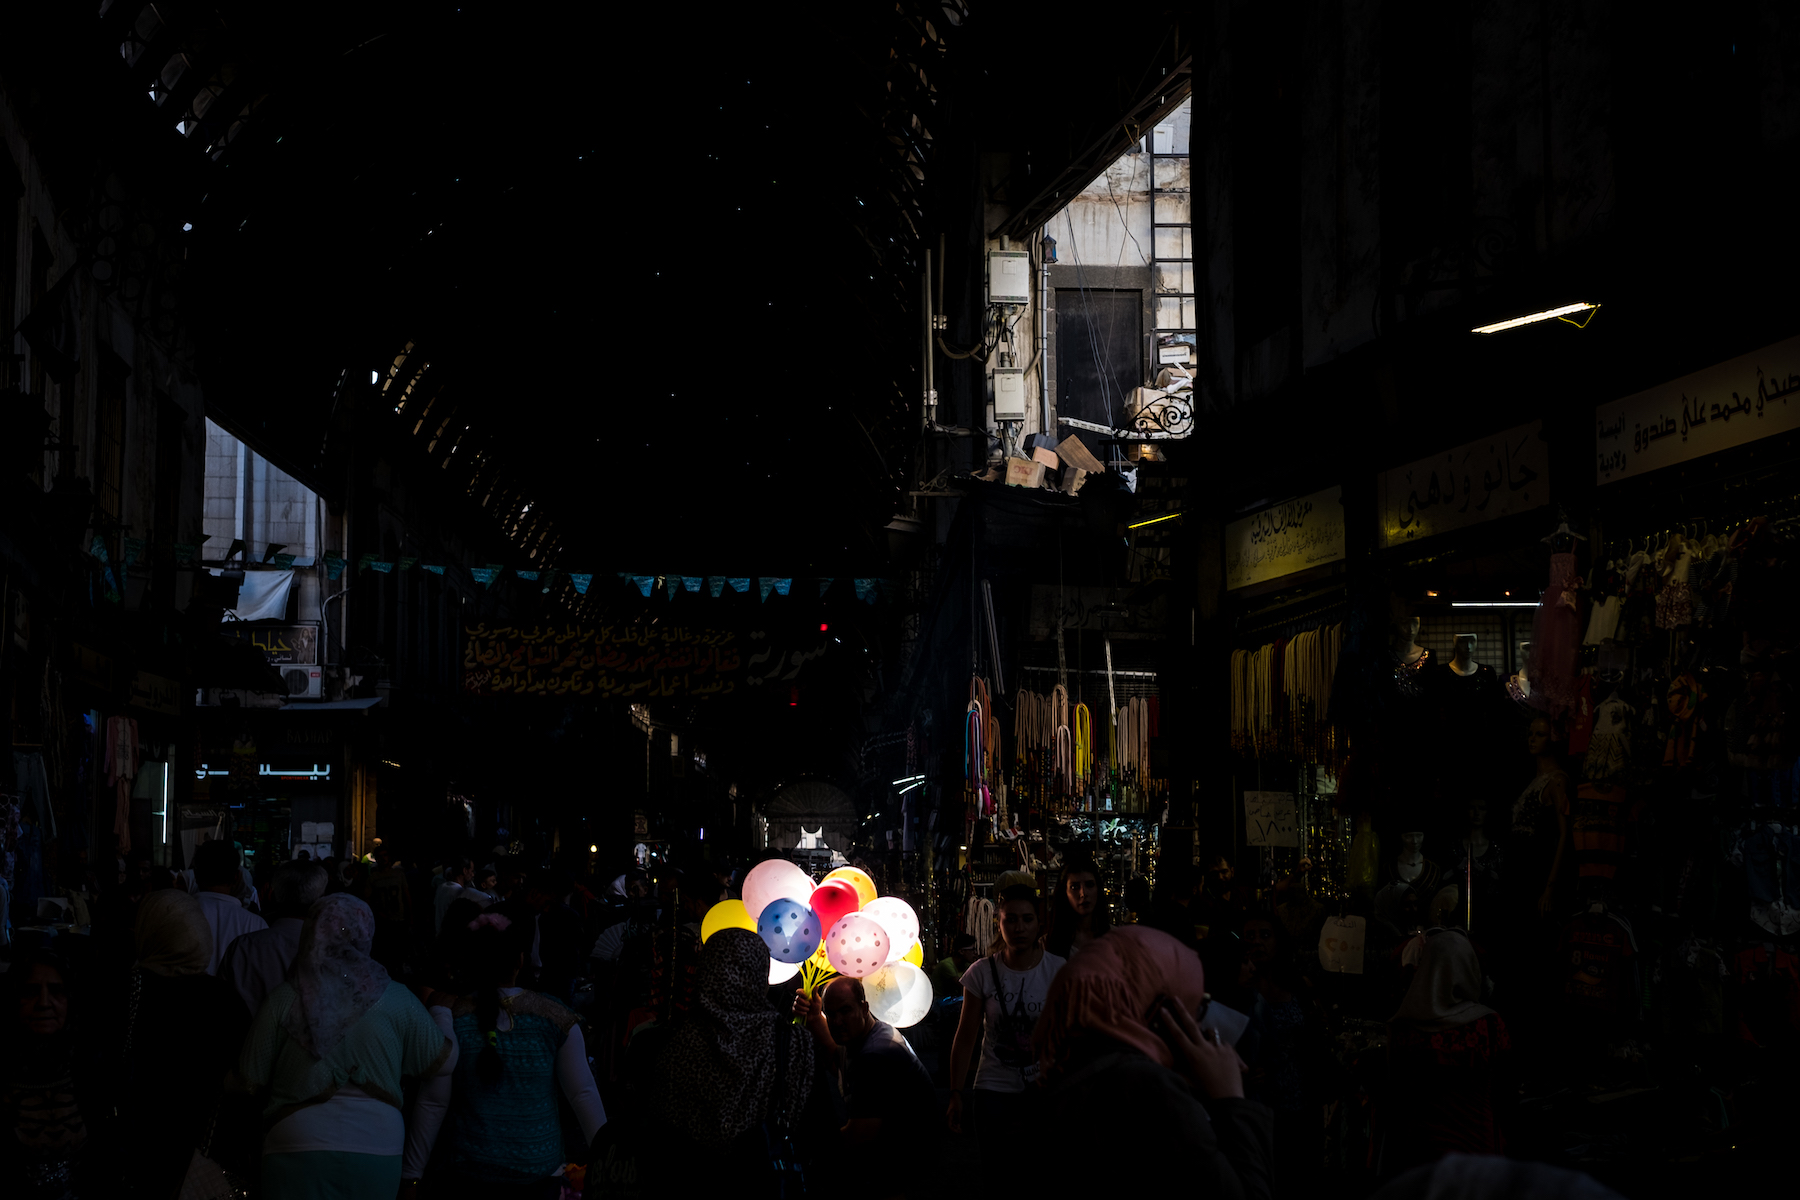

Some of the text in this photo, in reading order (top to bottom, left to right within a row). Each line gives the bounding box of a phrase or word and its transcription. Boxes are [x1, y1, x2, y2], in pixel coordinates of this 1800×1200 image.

[1681, 393, 1707, 443] علي
[1711, 392, 1751, 421] محمد
[1634, 414, 1677, 453] صندوق
[465, 622, 736, 648] عزيزة وغالية على قلب كل مواطن عربي وسوري
[509, 644, 560, 673] التسامح
[551, 641, 585, 674] شهر
[579, 644, 630, 673] رمضان
[627, 645, 660, 673] شهر
[746, 630, 828, 686] سورية
[490, 667, 528, 694] واحدة
[546, 669, 596, 696] ونكون
[597, 669, 653, 699] سورية
[690, 673, 736, 701] ونعيد
[1255, 819, 1293, 842] ١٨٠٠
